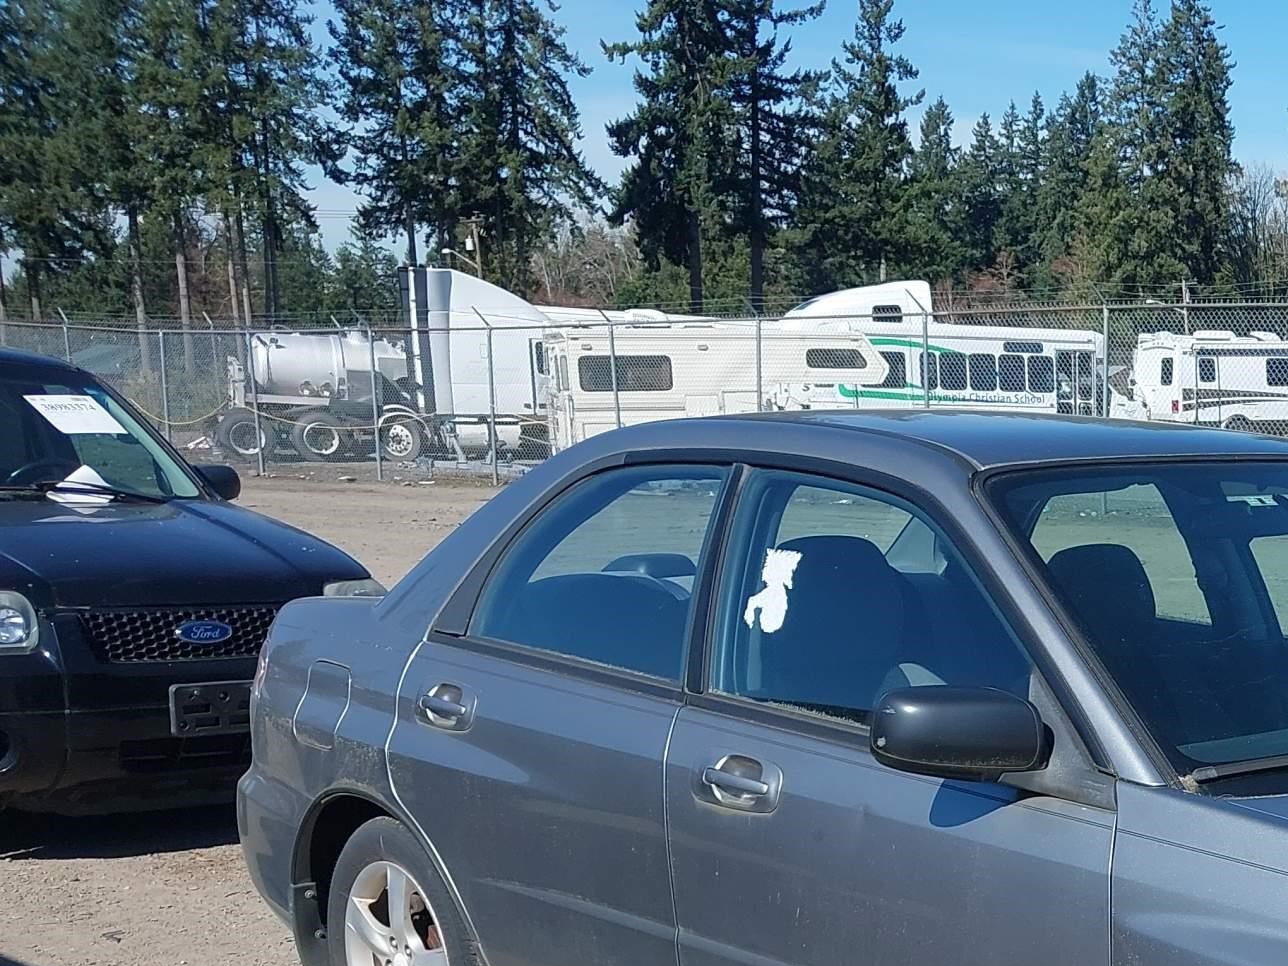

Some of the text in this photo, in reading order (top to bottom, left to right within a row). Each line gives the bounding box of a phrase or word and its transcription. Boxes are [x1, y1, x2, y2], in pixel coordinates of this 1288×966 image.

[928, 391, 1045, 404] Olympia Christian School
[190, 625, 221, 639] Ford
